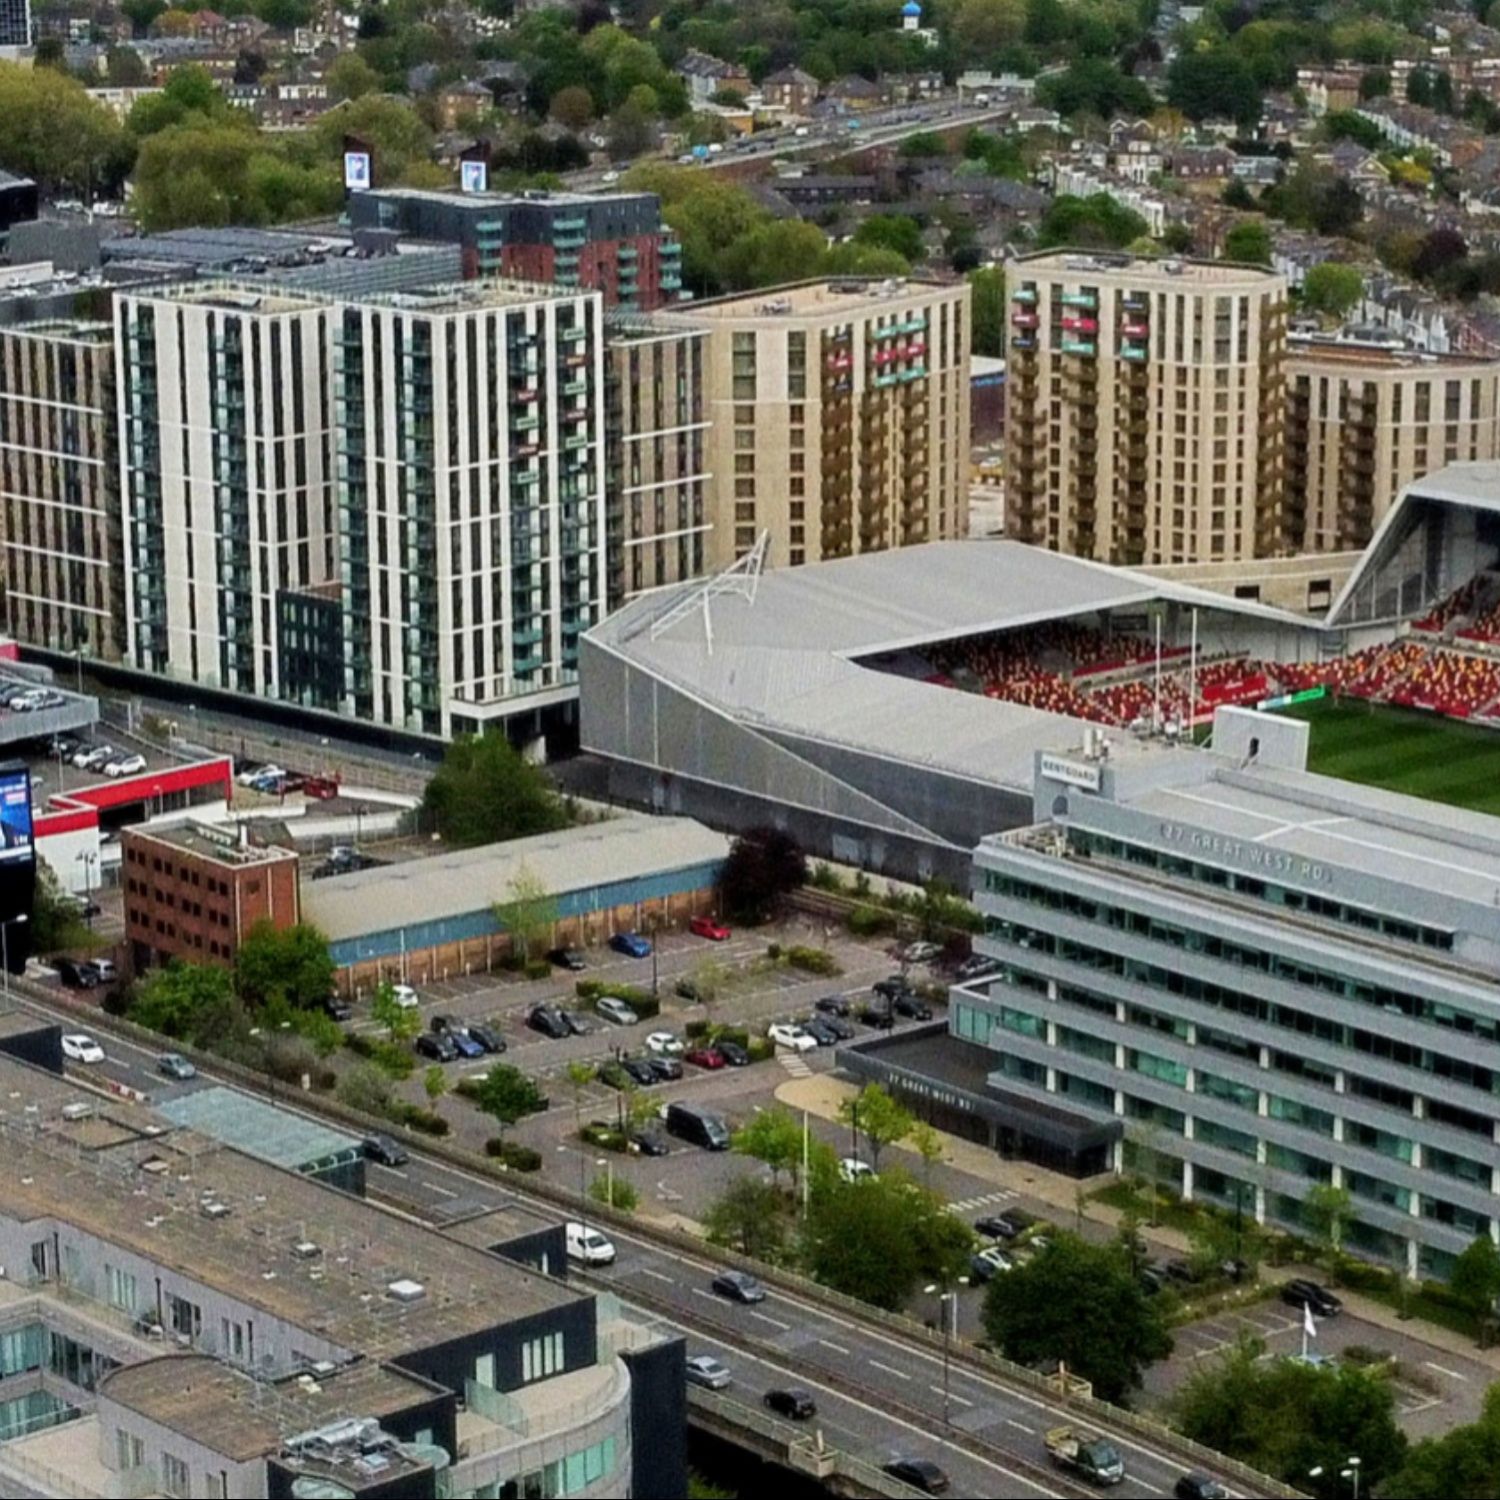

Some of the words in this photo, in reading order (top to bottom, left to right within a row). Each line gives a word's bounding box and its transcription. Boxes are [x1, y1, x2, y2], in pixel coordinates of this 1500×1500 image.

[1191, 832, 1241, 858] GREAT
[1250, 848, 1292, 872] WEST
[902, 1077, 929, 1094] GREAT
[932, 1089, 956, 1104] WEST
